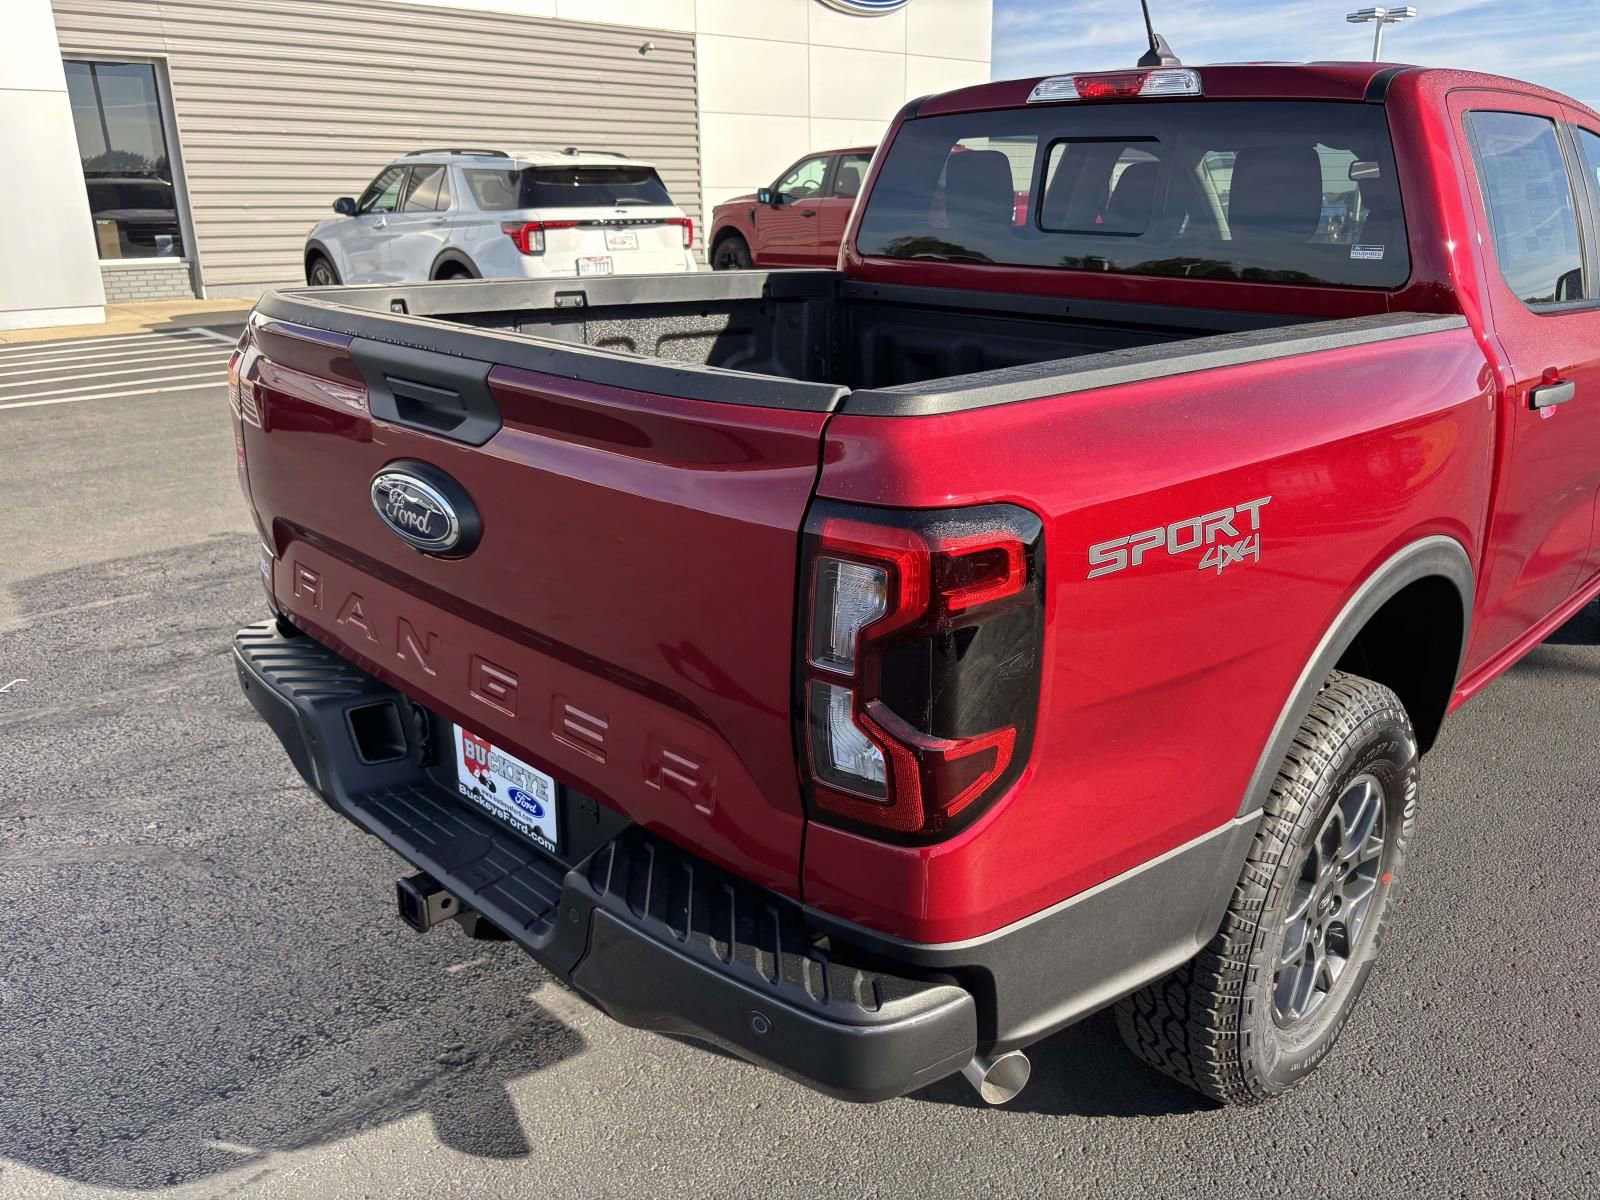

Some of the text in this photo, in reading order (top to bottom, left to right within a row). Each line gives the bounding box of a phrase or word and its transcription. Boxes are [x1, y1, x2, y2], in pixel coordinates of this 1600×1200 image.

[386, 488, 433, 535] Ford
[1087, 495, 1273, 579] SPORT
[1198, 532, 1260, 576] 4x4
[293, 561, 718, 816] RANGER
[464, 739, 548, 800] BUCKEYE
[459, 784, 555, 852] BuckeyeFord.com
[514, 790, 538, 815] Ford
